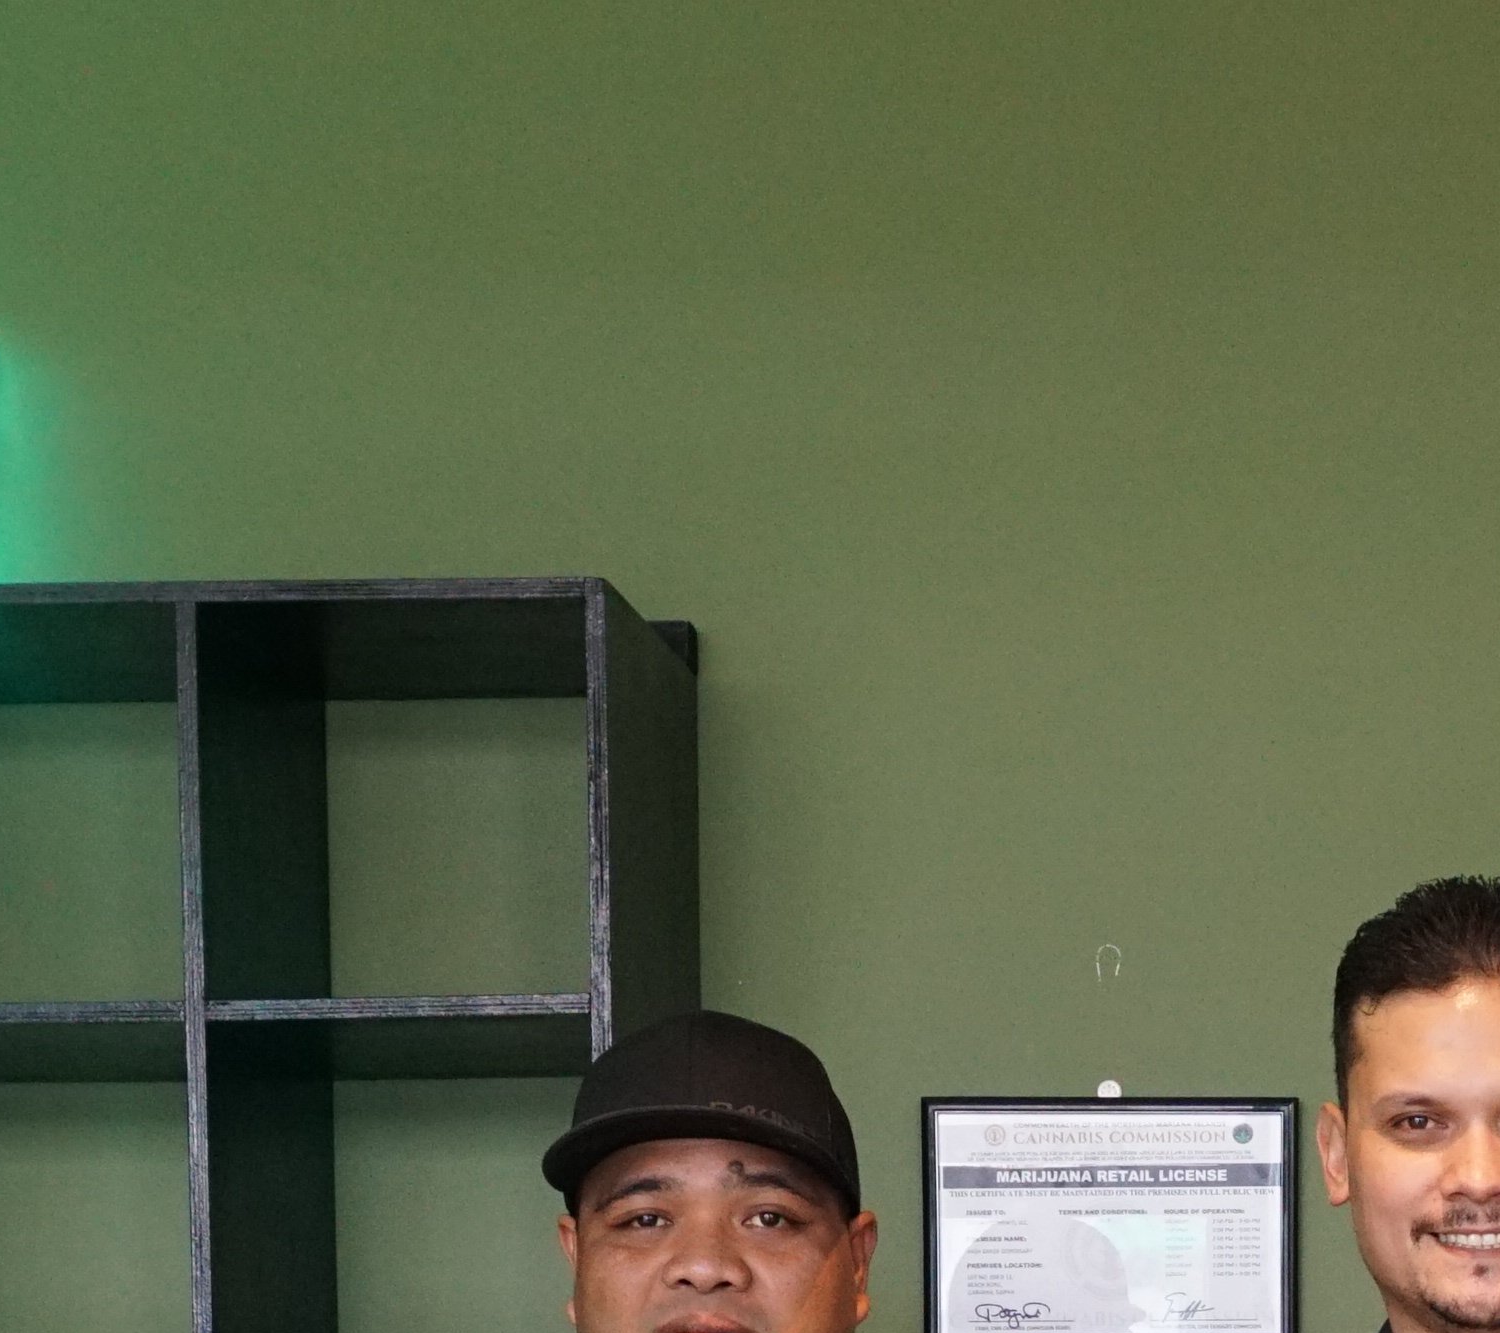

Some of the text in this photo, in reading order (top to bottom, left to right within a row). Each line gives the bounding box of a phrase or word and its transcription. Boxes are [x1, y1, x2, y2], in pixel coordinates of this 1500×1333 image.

[1013, 1131, 1226, 1145] CANNABIS COMMISSION
[996, 1169, 1228, 1184] MARIJUANA RETAIL LICENSE
